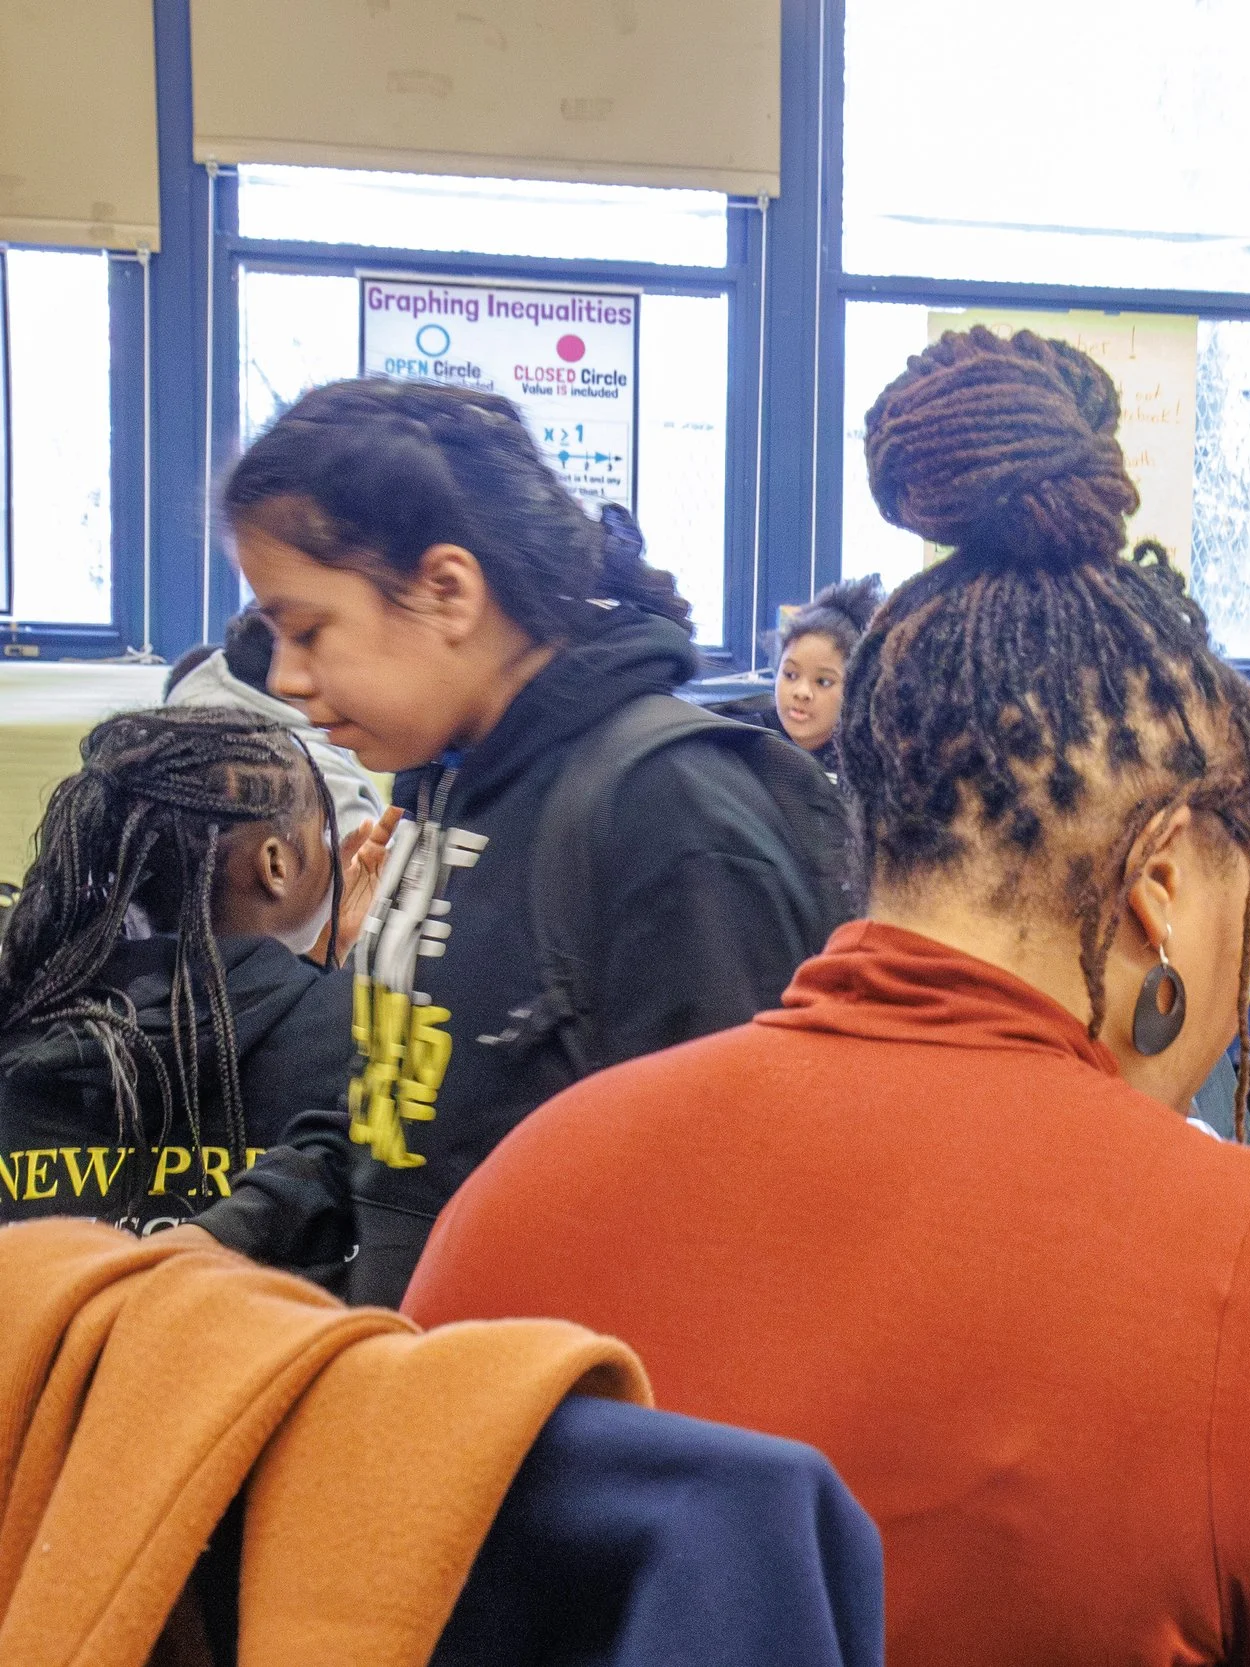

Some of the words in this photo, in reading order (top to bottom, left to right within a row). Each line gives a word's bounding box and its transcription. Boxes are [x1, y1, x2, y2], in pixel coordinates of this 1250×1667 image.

[368, 286, 479, 322] Graphing
[487, 294, 632, 326] Inequalities
[385, 358, 428, 376] OPEN
[434, 360, 481, 379] Circle
[514, 364, 576, 383] CLOSED
[581, 368, 627, 386] Circle
[522, 382, 553, 396] Value
[557, 384, 567, 396] IS
[571, 385, 618, 399] included
[0, 1147, 134, 1200] NEW
[148, 1146, 266, 1198] PR
